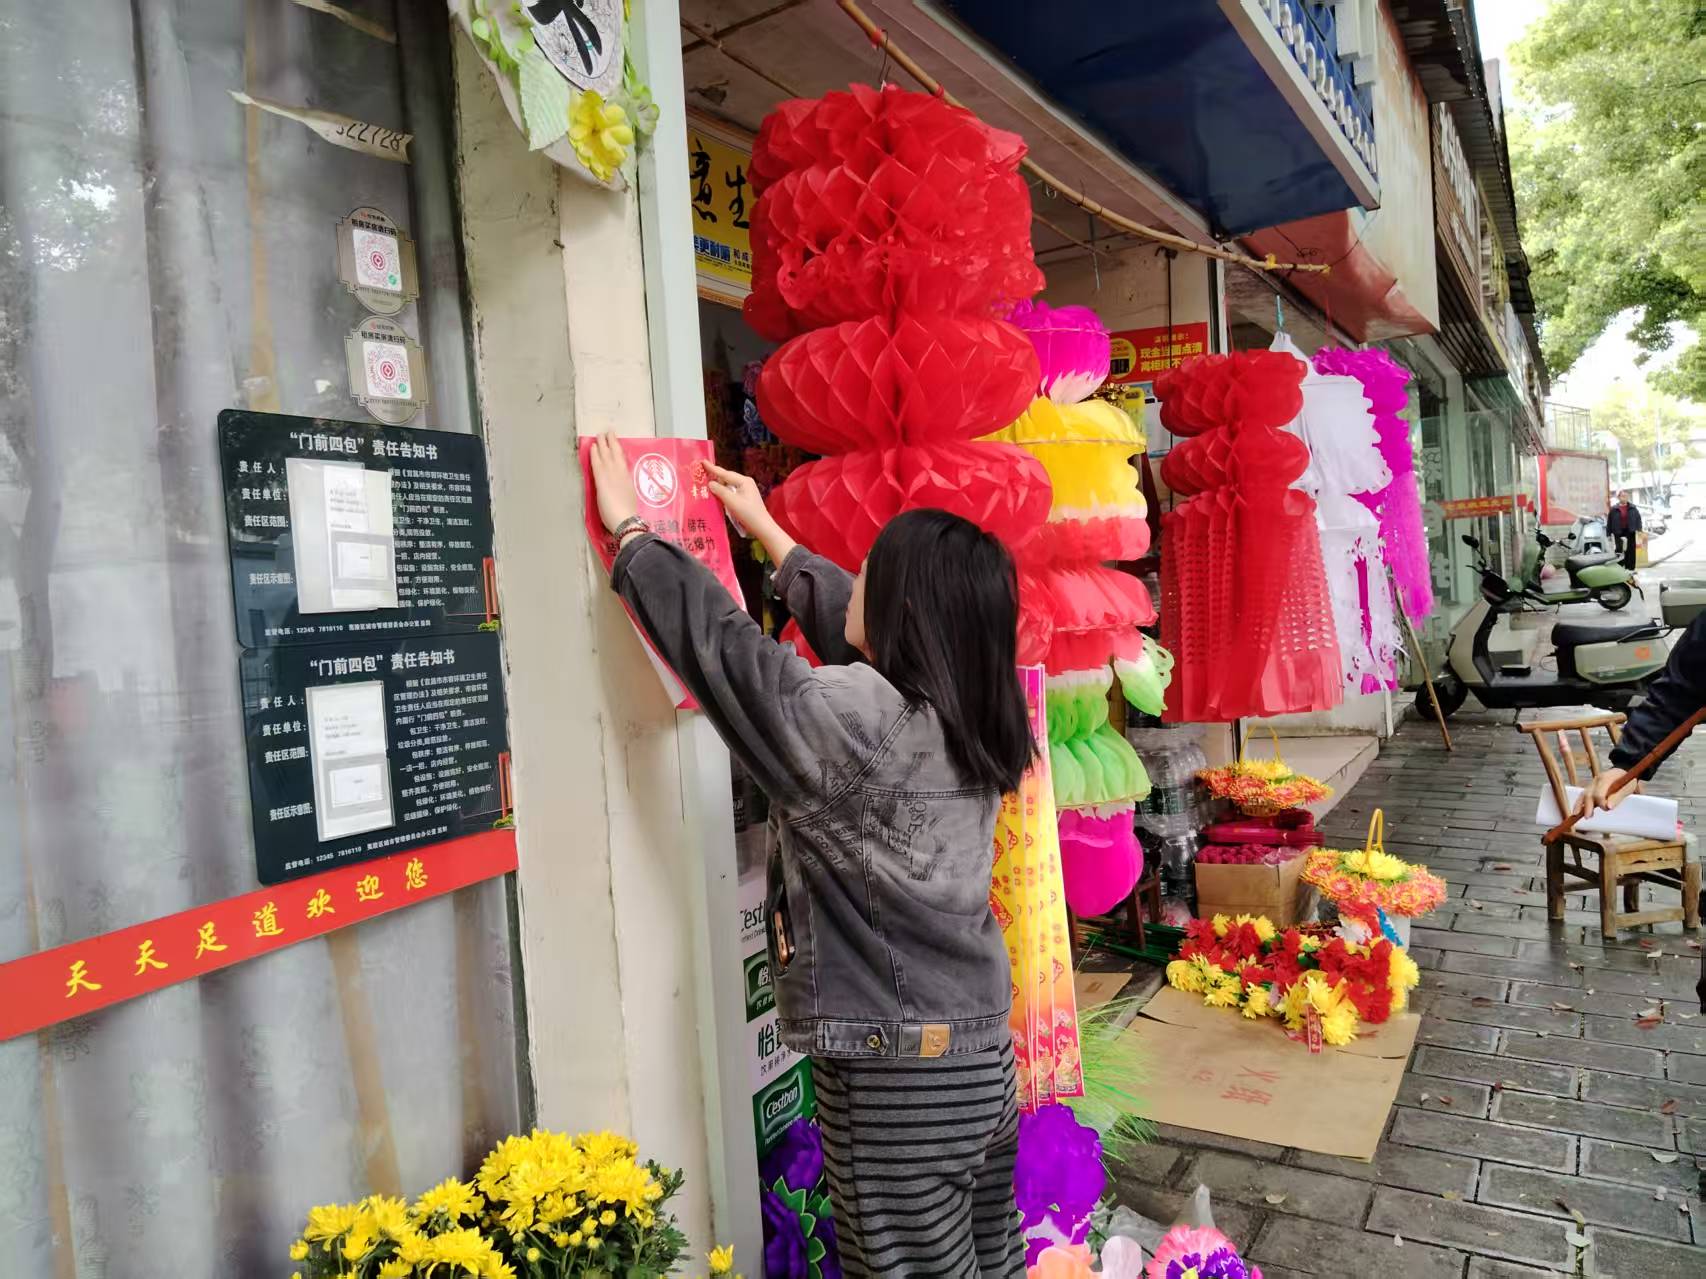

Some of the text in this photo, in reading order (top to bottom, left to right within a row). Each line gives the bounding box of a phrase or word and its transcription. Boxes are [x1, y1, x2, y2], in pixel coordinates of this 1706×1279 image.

[296, 626, 315, 634] 12345
[316, 853, 334, 862] 12345
[65, 858, 430, 998] 天天足道欢迎您
